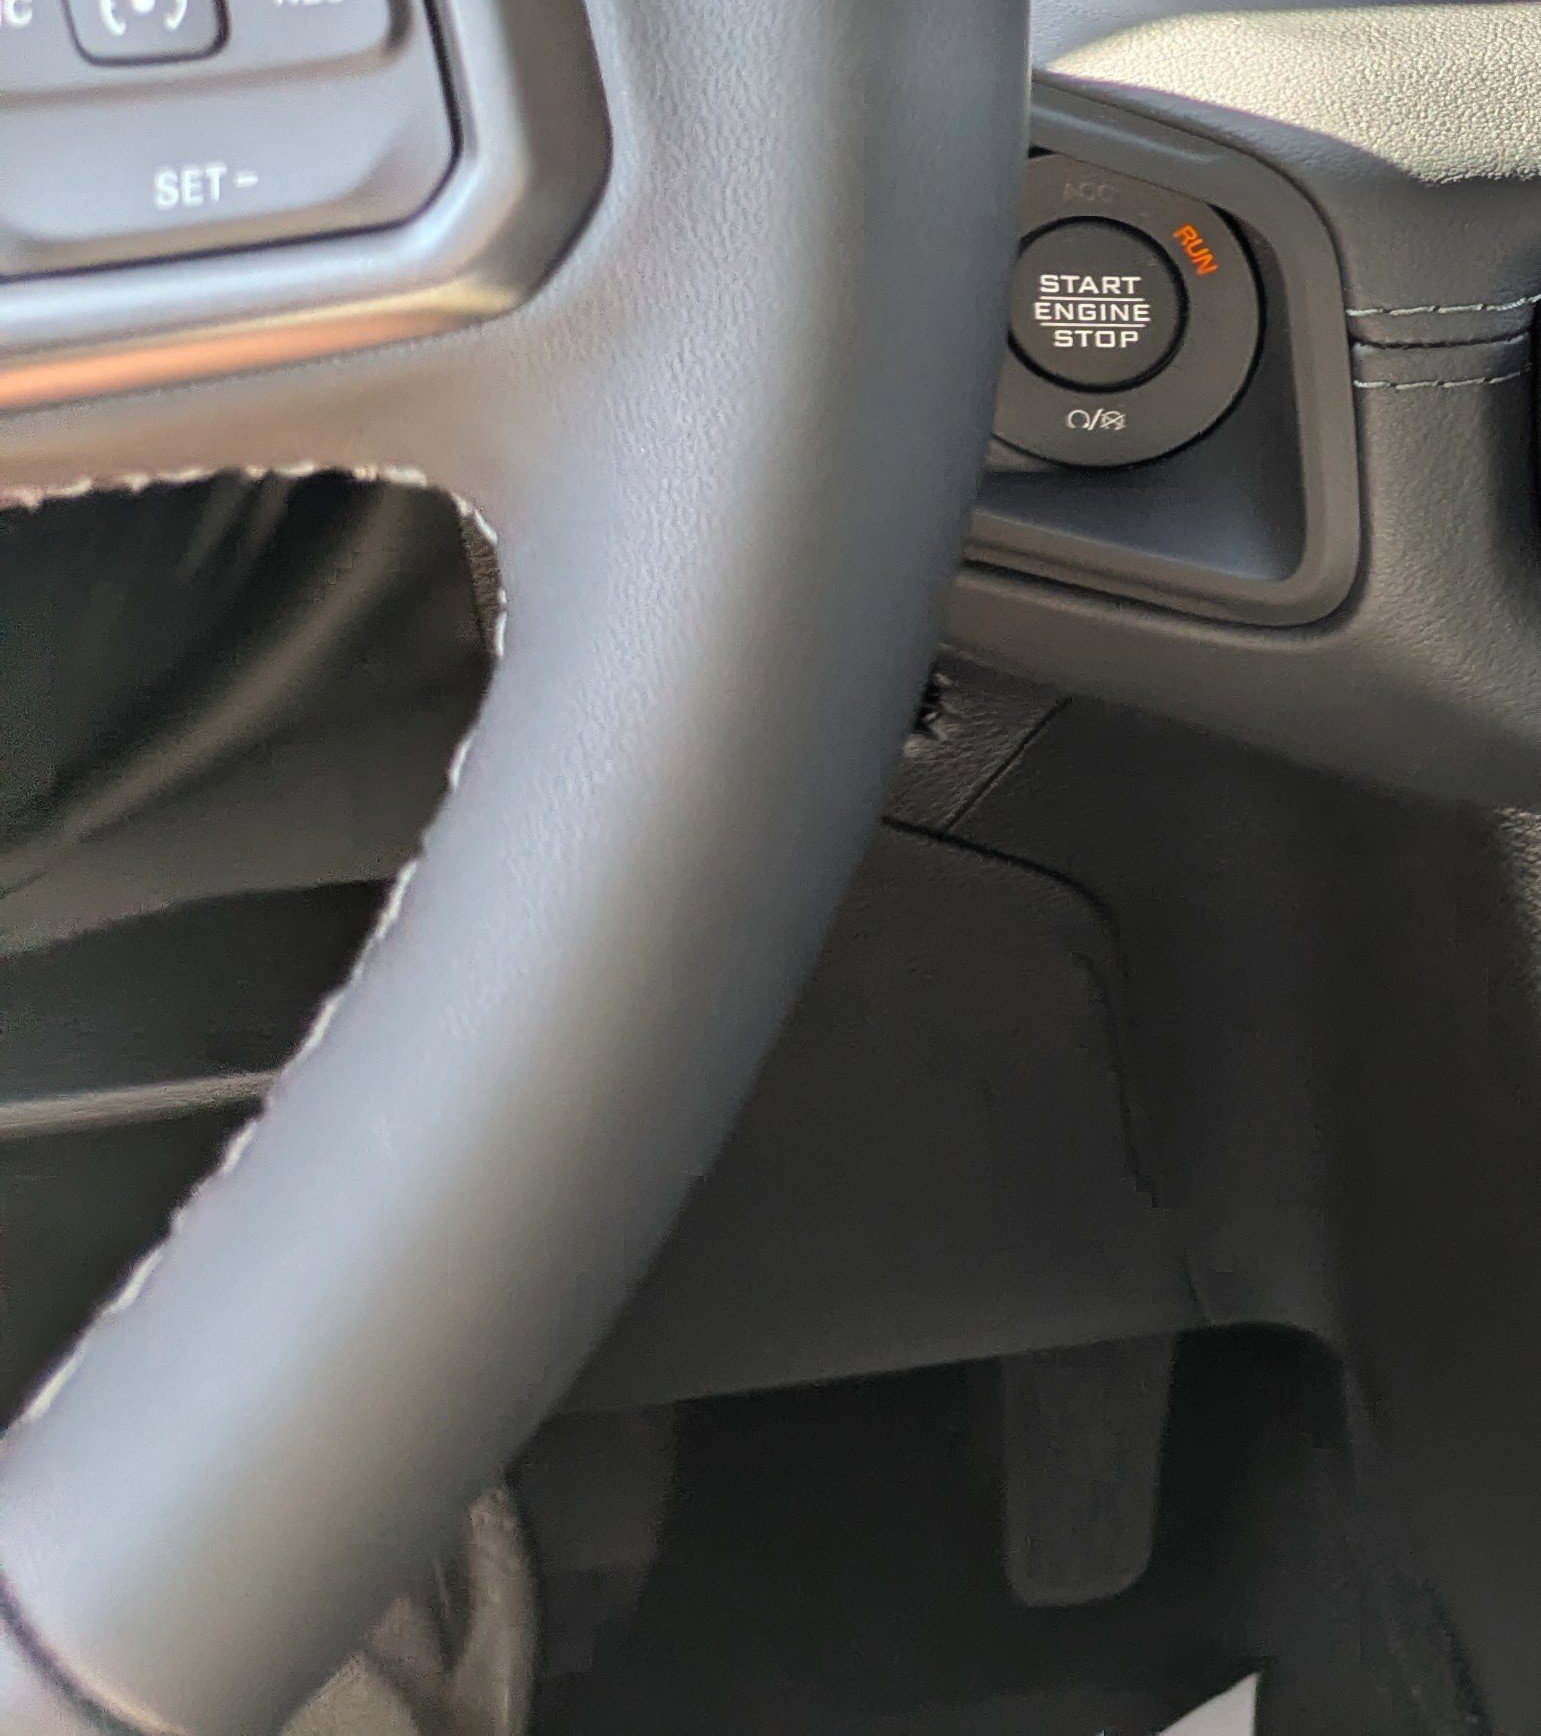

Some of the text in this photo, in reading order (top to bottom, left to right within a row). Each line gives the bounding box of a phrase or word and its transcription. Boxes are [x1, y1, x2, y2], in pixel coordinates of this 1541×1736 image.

[1173, 223, 1219, 277] RUN
[1039, 274, 1143, 295] START
[1033, 301, 1151, 322] ENGINE
[1053, 329, 1140, 348] STOP
